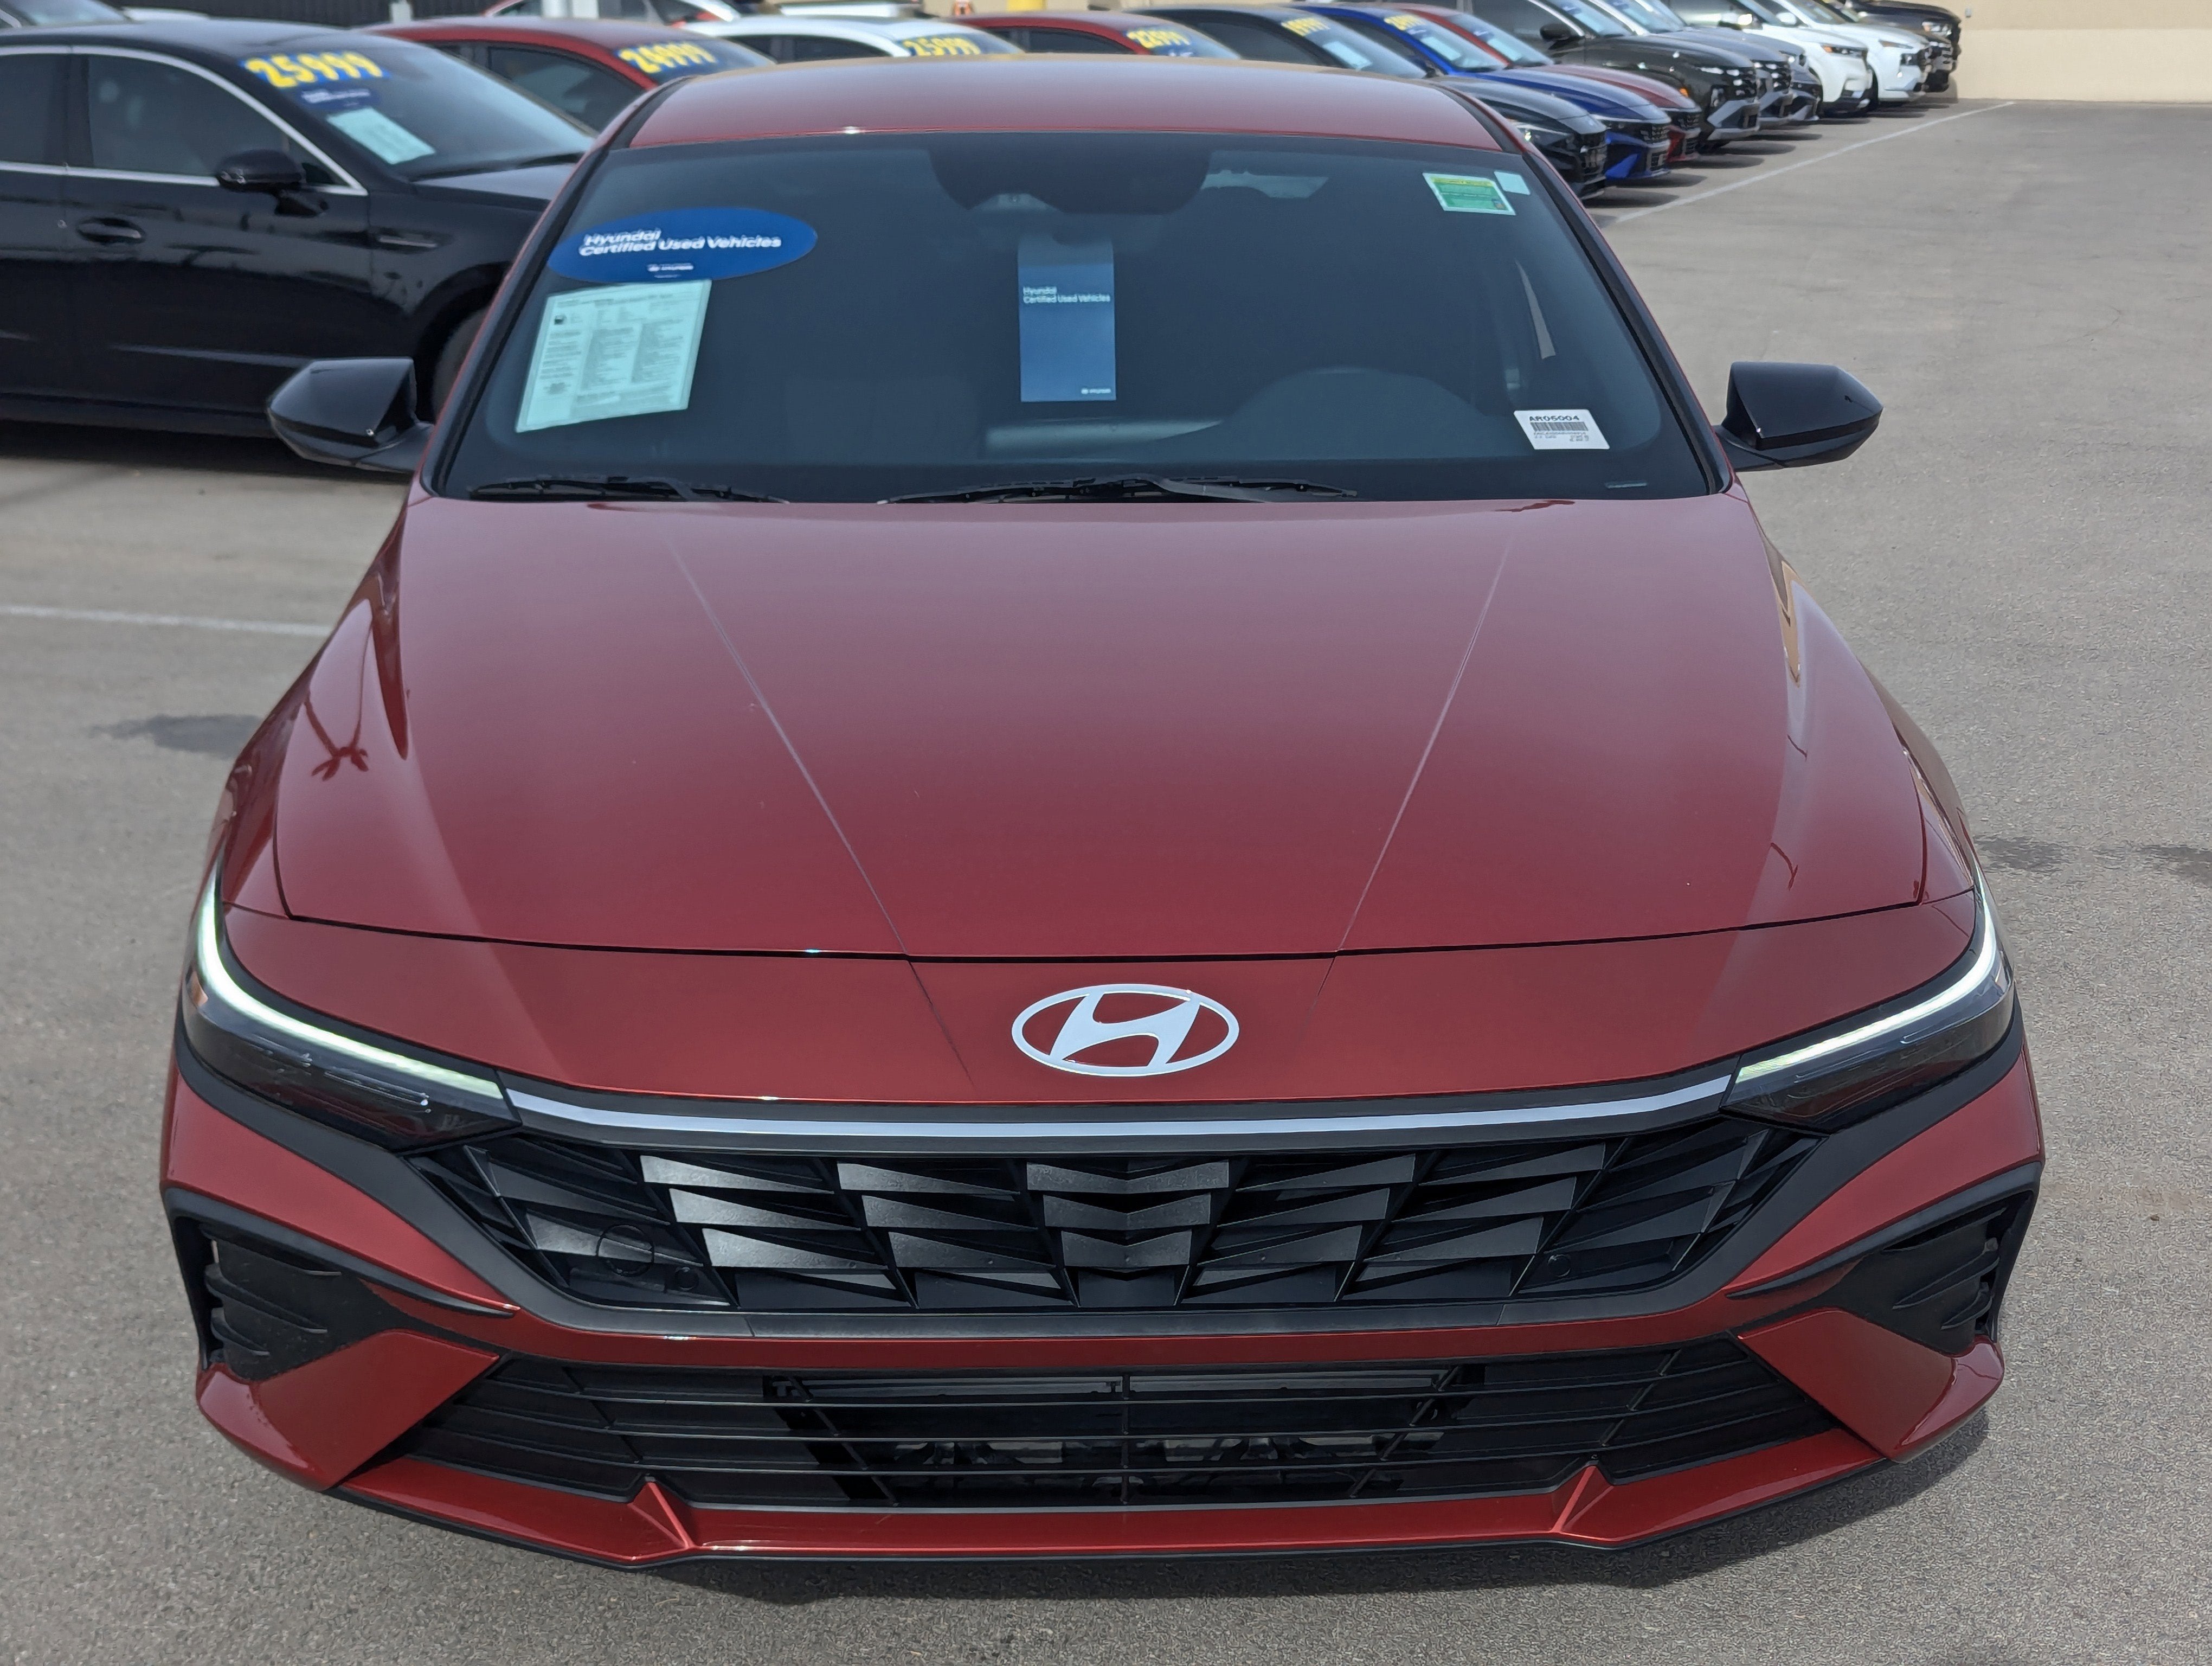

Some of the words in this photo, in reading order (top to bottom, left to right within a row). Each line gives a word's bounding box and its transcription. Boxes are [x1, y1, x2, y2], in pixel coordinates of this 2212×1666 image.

[246, 52, 383, 88] 25999
[578, 241, 657, 256] Certified
[658, 236, 705, 251] Used
[706, 234, 782, 249] Vehicles
[584, 228, 661, 246] Hyundai
